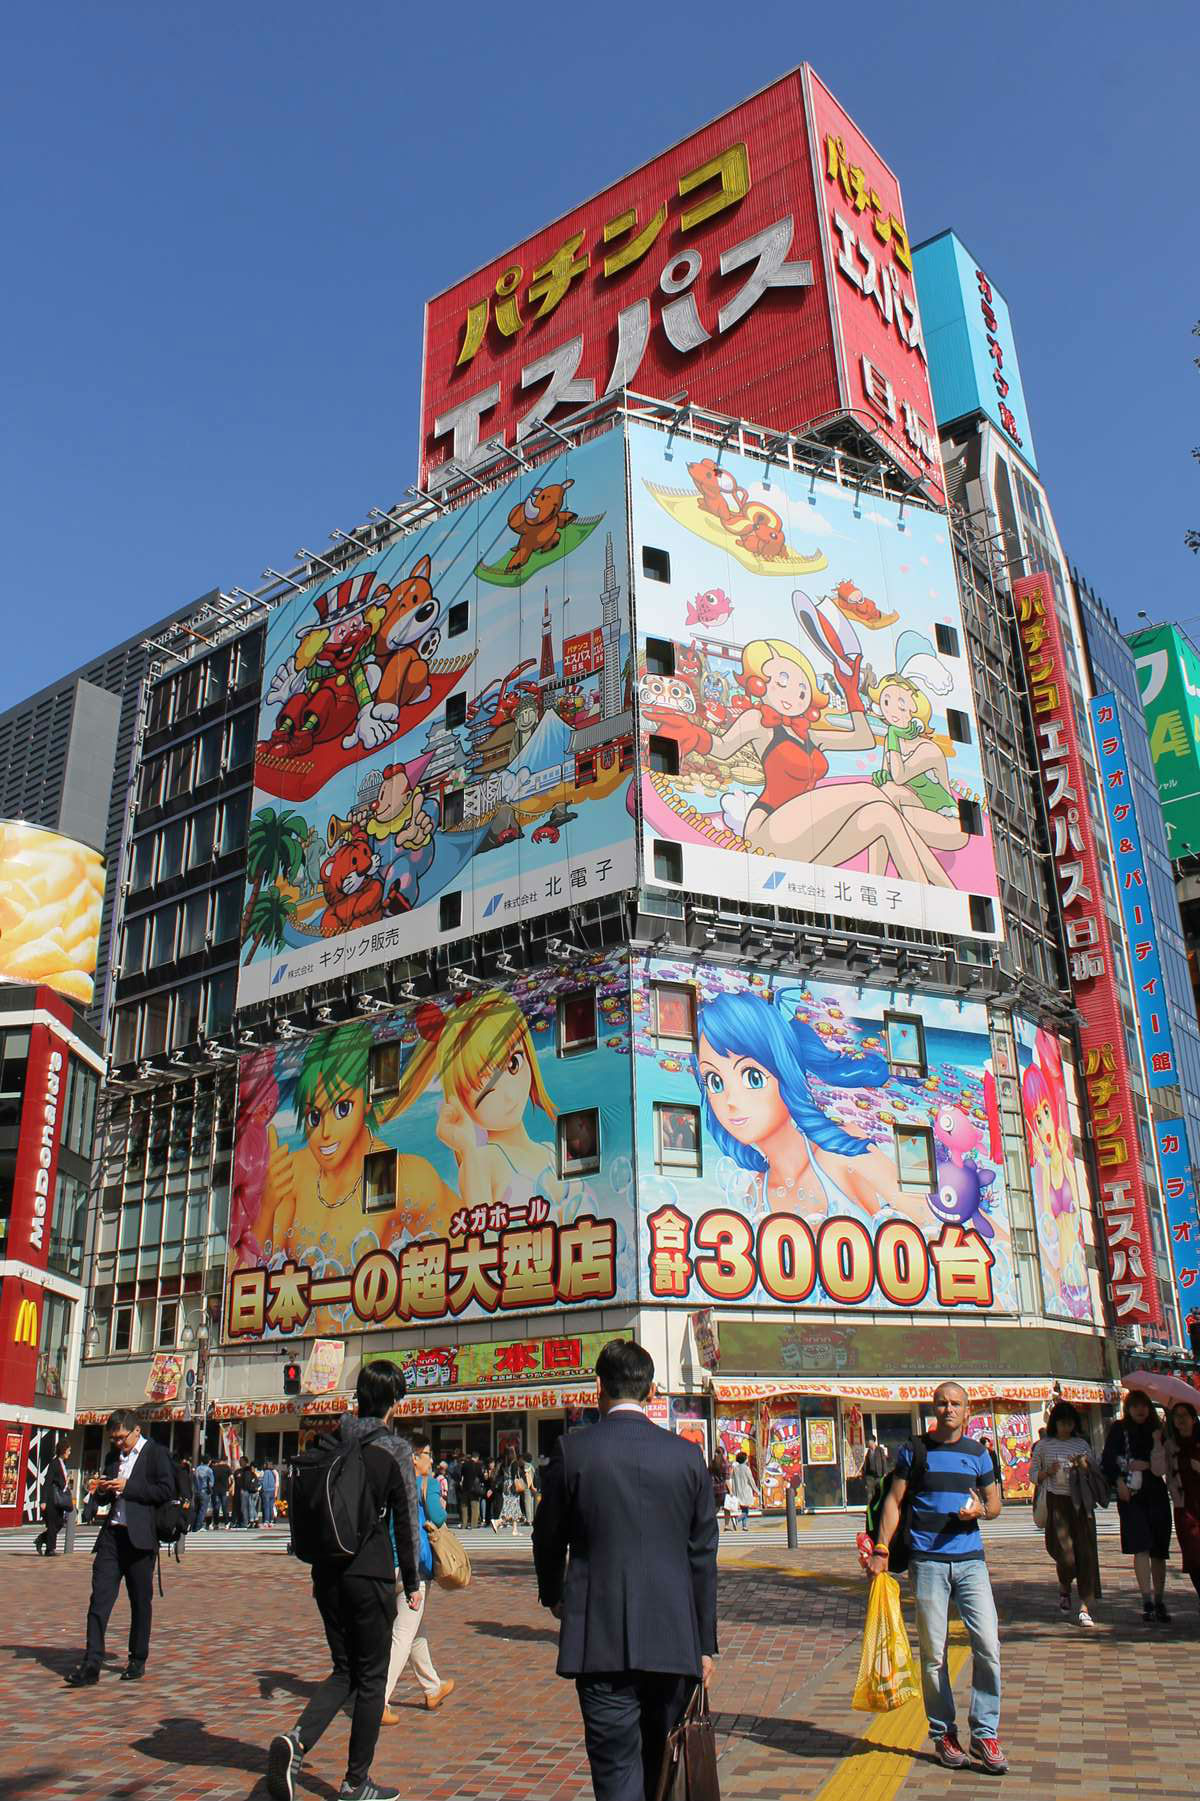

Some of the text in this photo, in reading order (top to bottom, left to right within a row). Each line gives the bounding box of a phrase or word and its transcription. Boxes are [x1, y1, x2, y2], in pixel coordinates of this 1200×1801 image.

[457, 142, 752, 367] パチンコ
[825, 132, 913, 272] パチンコ
[833, 207, 929, 366] エスパス
[428, 214, 814, 492] エスパス
[564, 650, 590, 665] エスパス
[1020, 588, 1061, 714] パチンコ
[504, 858, 613, 911] 株式会社 北電子
[787, 880, 903, 910] 株式会社 北電子
[288, 927, 400, 978] 株式会社 キタック販売
[449, 1195, 550, 1236] メガホール
[1086, 1041, 1150, 1316] パチンコ エスパス
[230, 1215, 617, 1337] 日本一の超大型店
[647, 1203, 996, 1307] 合計 3000台
[495, 1339, 582, 1372] 本日
